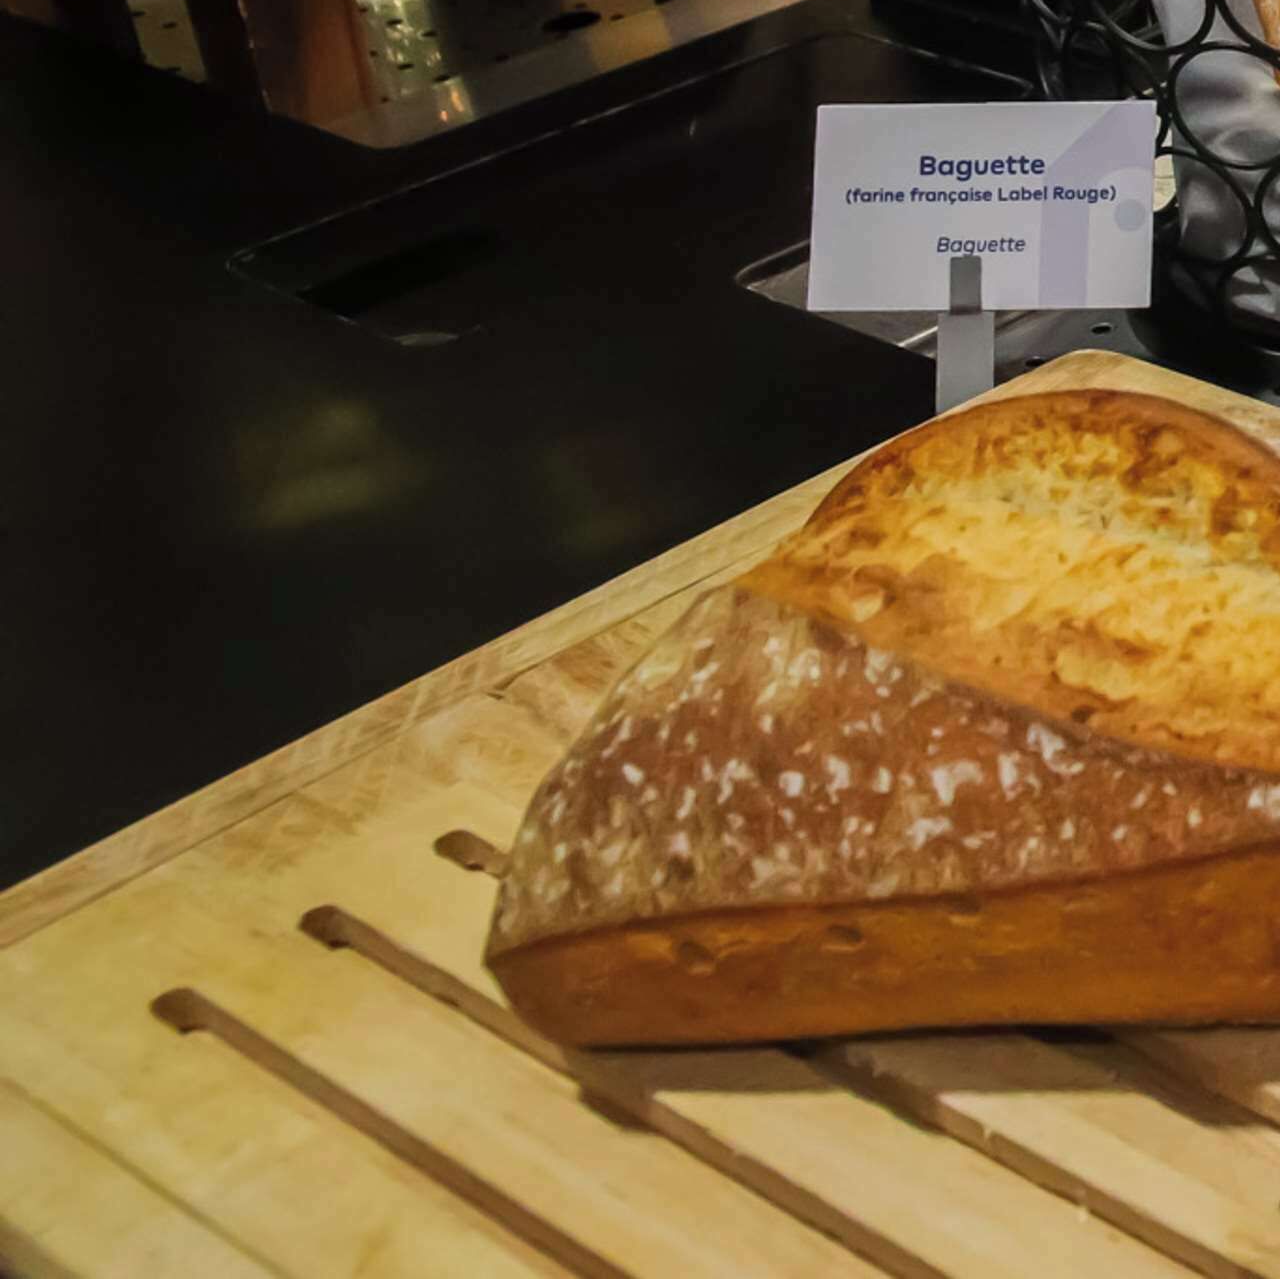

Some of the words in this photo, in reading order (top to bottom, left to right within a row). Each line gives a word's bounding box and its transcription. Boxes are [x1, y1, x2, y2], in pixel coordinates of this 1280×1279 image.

[919, 155, 1046, 182] Baguette
[845, 187, 905, 205] (farine
[910, 187, 993, 206] française
[998, 185, 1048, 202] Label
[1053, 184, 1117, 204] Rouge)
[936, 236, 1026, 256] Baguette
